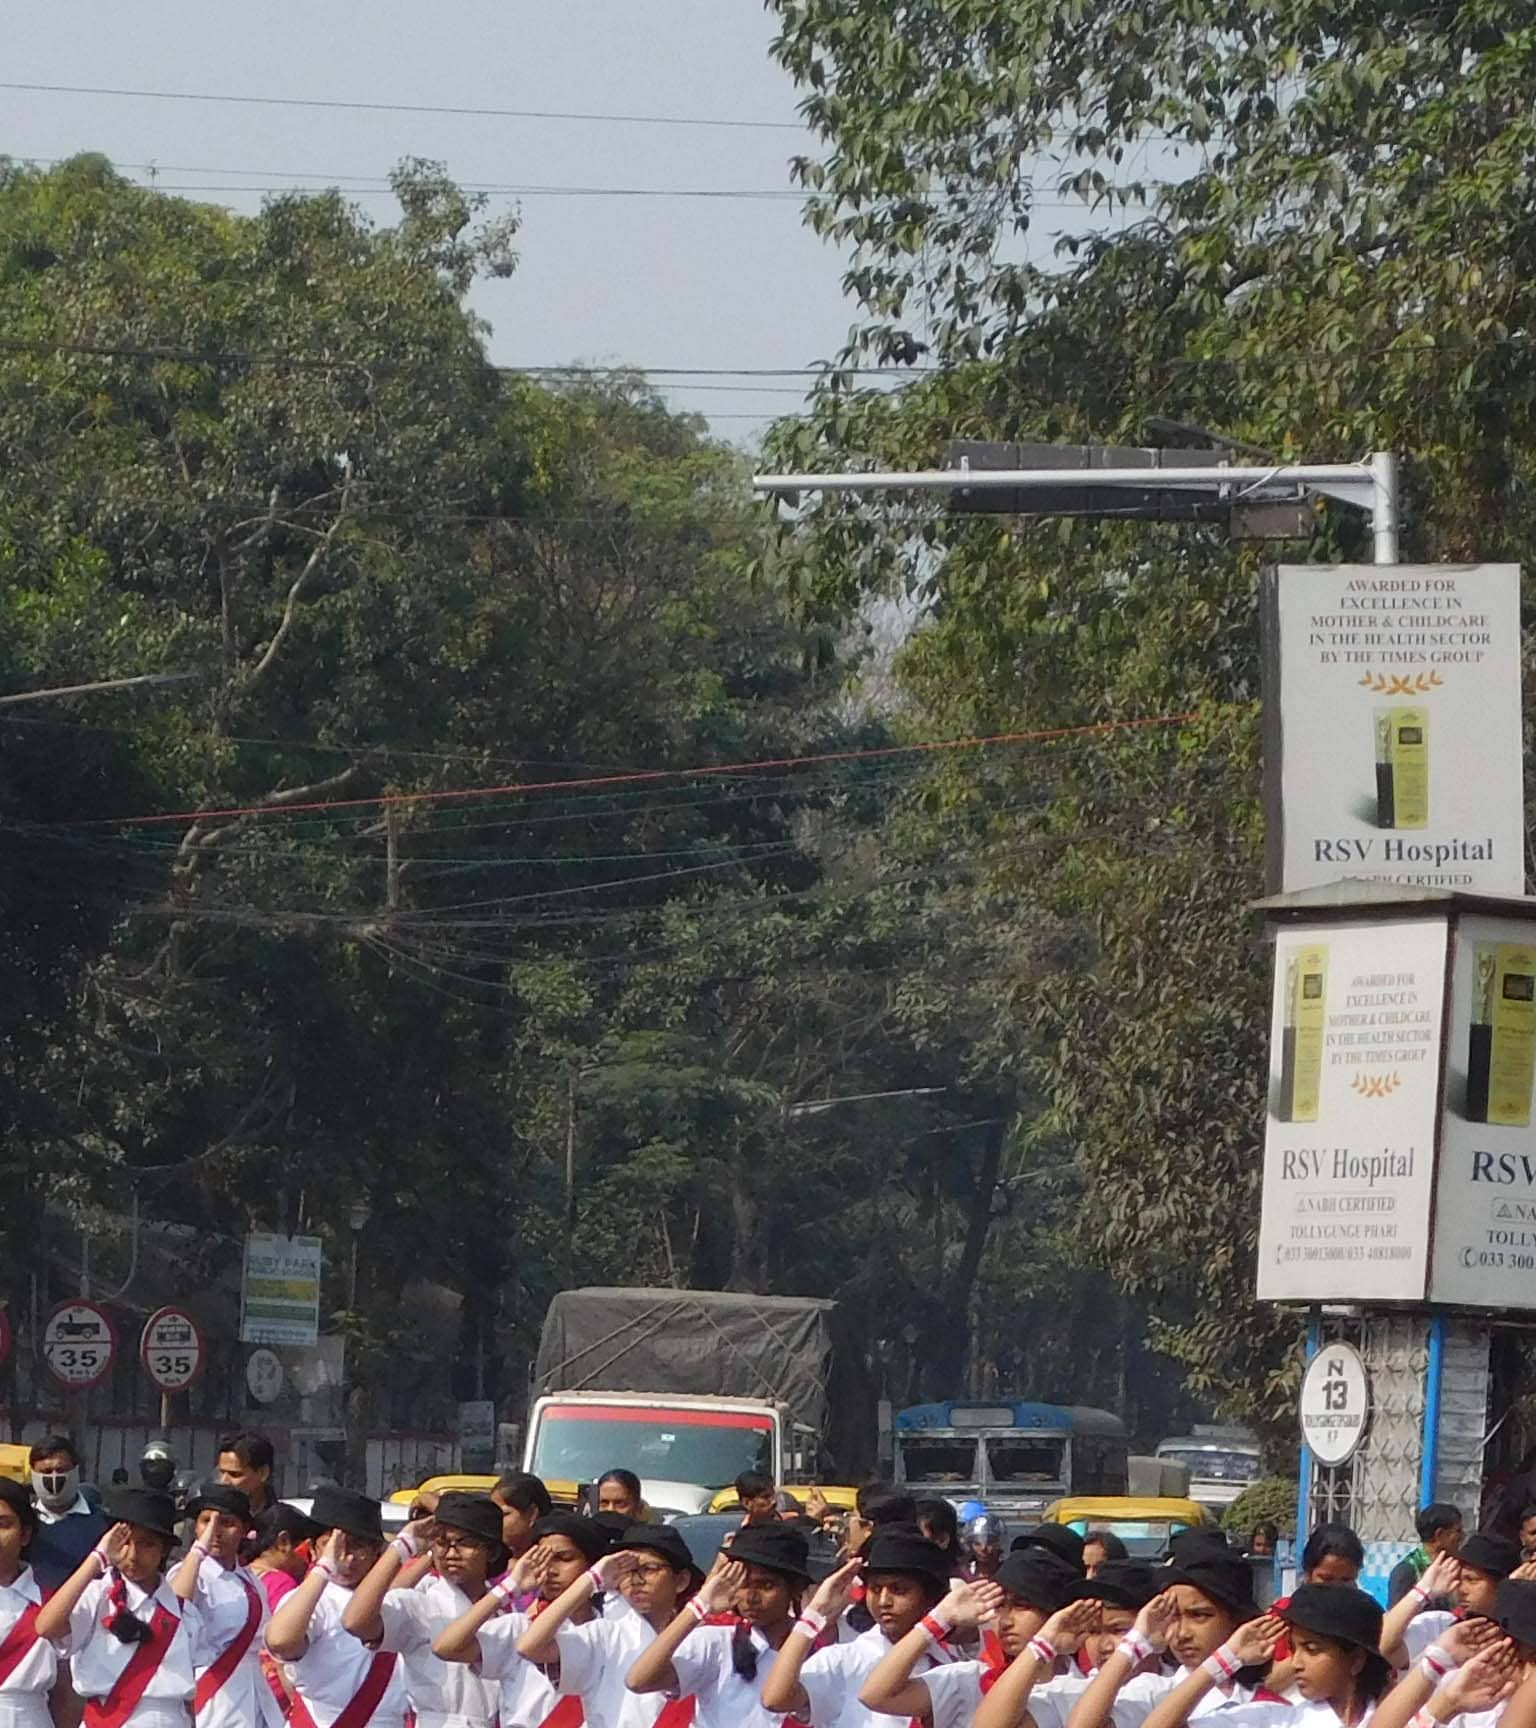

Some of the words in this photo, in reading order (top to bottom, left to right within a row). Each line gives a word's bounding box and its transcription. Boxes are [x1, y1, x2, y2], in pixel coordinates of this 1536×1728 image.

[1346, 580, 1421, 592] AWARDED
[1425, 580, 1456, 592] FOR
[1340, 598, 1443, 610] EXCELLENCE
[1447, 598, 1462, 609] IN
[1311, 615, 1378, 628] MOTHER
[1382, 616, 1393, 628] &
[1398, 615, 1488, 628] CHILDCARE
[1310, 633, 1324, 645] IN
[1329, 633, 1360, 645] THE
[1365, 633, 1426, 645] HEALTH
[1430, 633, 1491, 645] SECTOR
[1320, 651, 1339, 663] BY
[1344, 651, 1376, 663] THE
[1379, 651, 1426, 663] TIMES
[1430, 651, 1484, 664] GROUP
[1314, 839, 1373, 862] RSV
[1384, 838, 1493, 867] Hospital
[1351, 974, 1394, 987] AWARDED
[1396, 973, 1415, 986] FOR
[1347, 992, 1406, 1008] EXCELLENCE
[1407, 991, 1417, 1004] IN
[1329, 1014, 1367, 1026] MOTHER
[1368, 1015, 1375, 1026] &
[1378, 1010, 1431, 1026] CHILDCARE
[1327, 1033, 1336, 1046] IN
[1339, 1032, 1356, 1046] THE
[1358, 1032, 1393, 1046] HEALTH
[1394, 1029, 1431, 1043] SECTOR
[1331, 1053, 1342, 1064] BY
[1345, 1052, 1363, 1064] THE
[1366, 1050, 1392, 1064] TIMES
[1395, 1049, 1426, 1062] GROUP
[1281, 1149, 1326, 1180] RSV
[1332, 1147, 1414, 1187] Hospital
[1308, 1197, 1336, 1212] NABH
[1339, 1196, 1395, 1212] CERTIFIED
[1290, 1224, 1360, 1239] TOLLYGUNGE
[1364, 1224, 1397, 1238] PHARI
[1479, 1252, 1504, 1267] 033
[60, 1350, 97, 1369] 35
[155, 1356, 191, 1376] 35
[1328, 1360, 1344, 1377] N
[1322, 1381, 1348, 1410] 13
